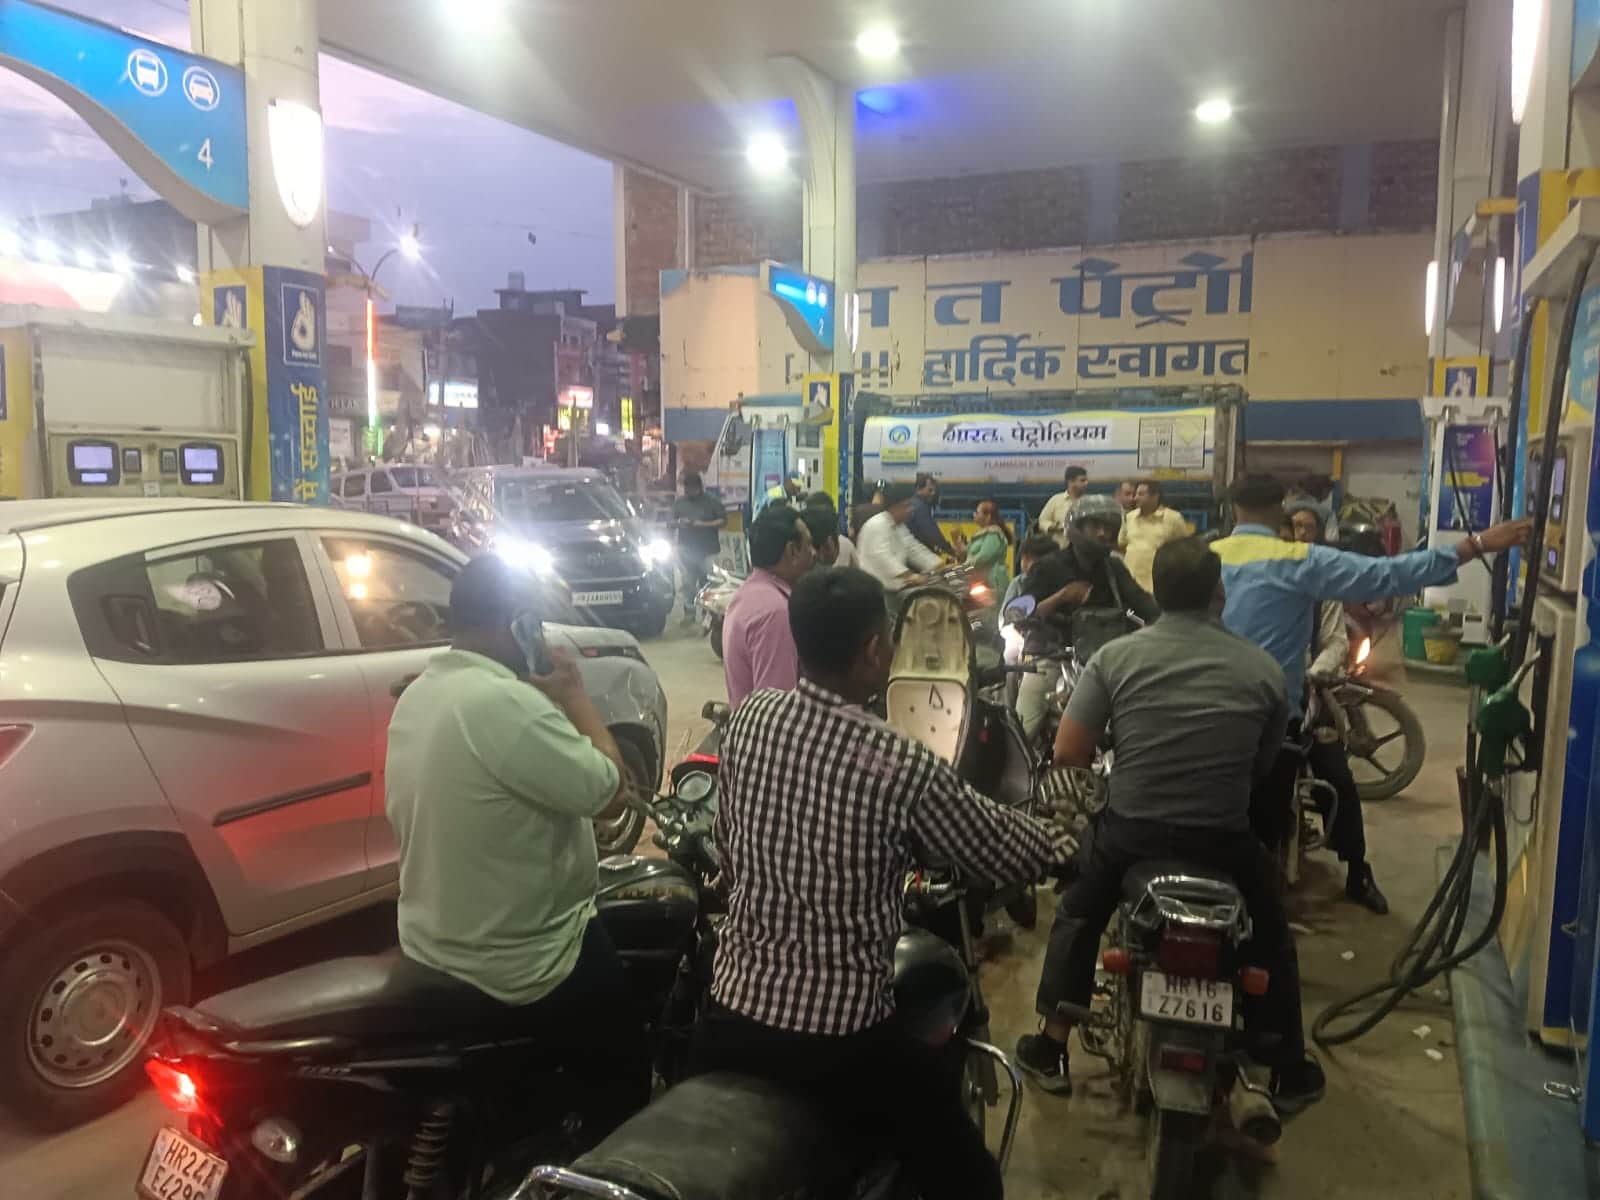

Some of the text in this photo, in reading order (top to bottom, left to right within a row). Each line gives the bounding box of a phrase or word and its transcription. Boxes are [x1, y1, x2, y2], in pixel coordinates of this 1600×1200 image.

[197, 138, 214, 169] 4
[1051, 252, 1254, 328] पेट्रो
[925, 334, 1066, 387] हार्दिक
[1011, 420, 1108, 447] पेट्रोलियम
[1158, 995, 1223, 1022] Z7616
